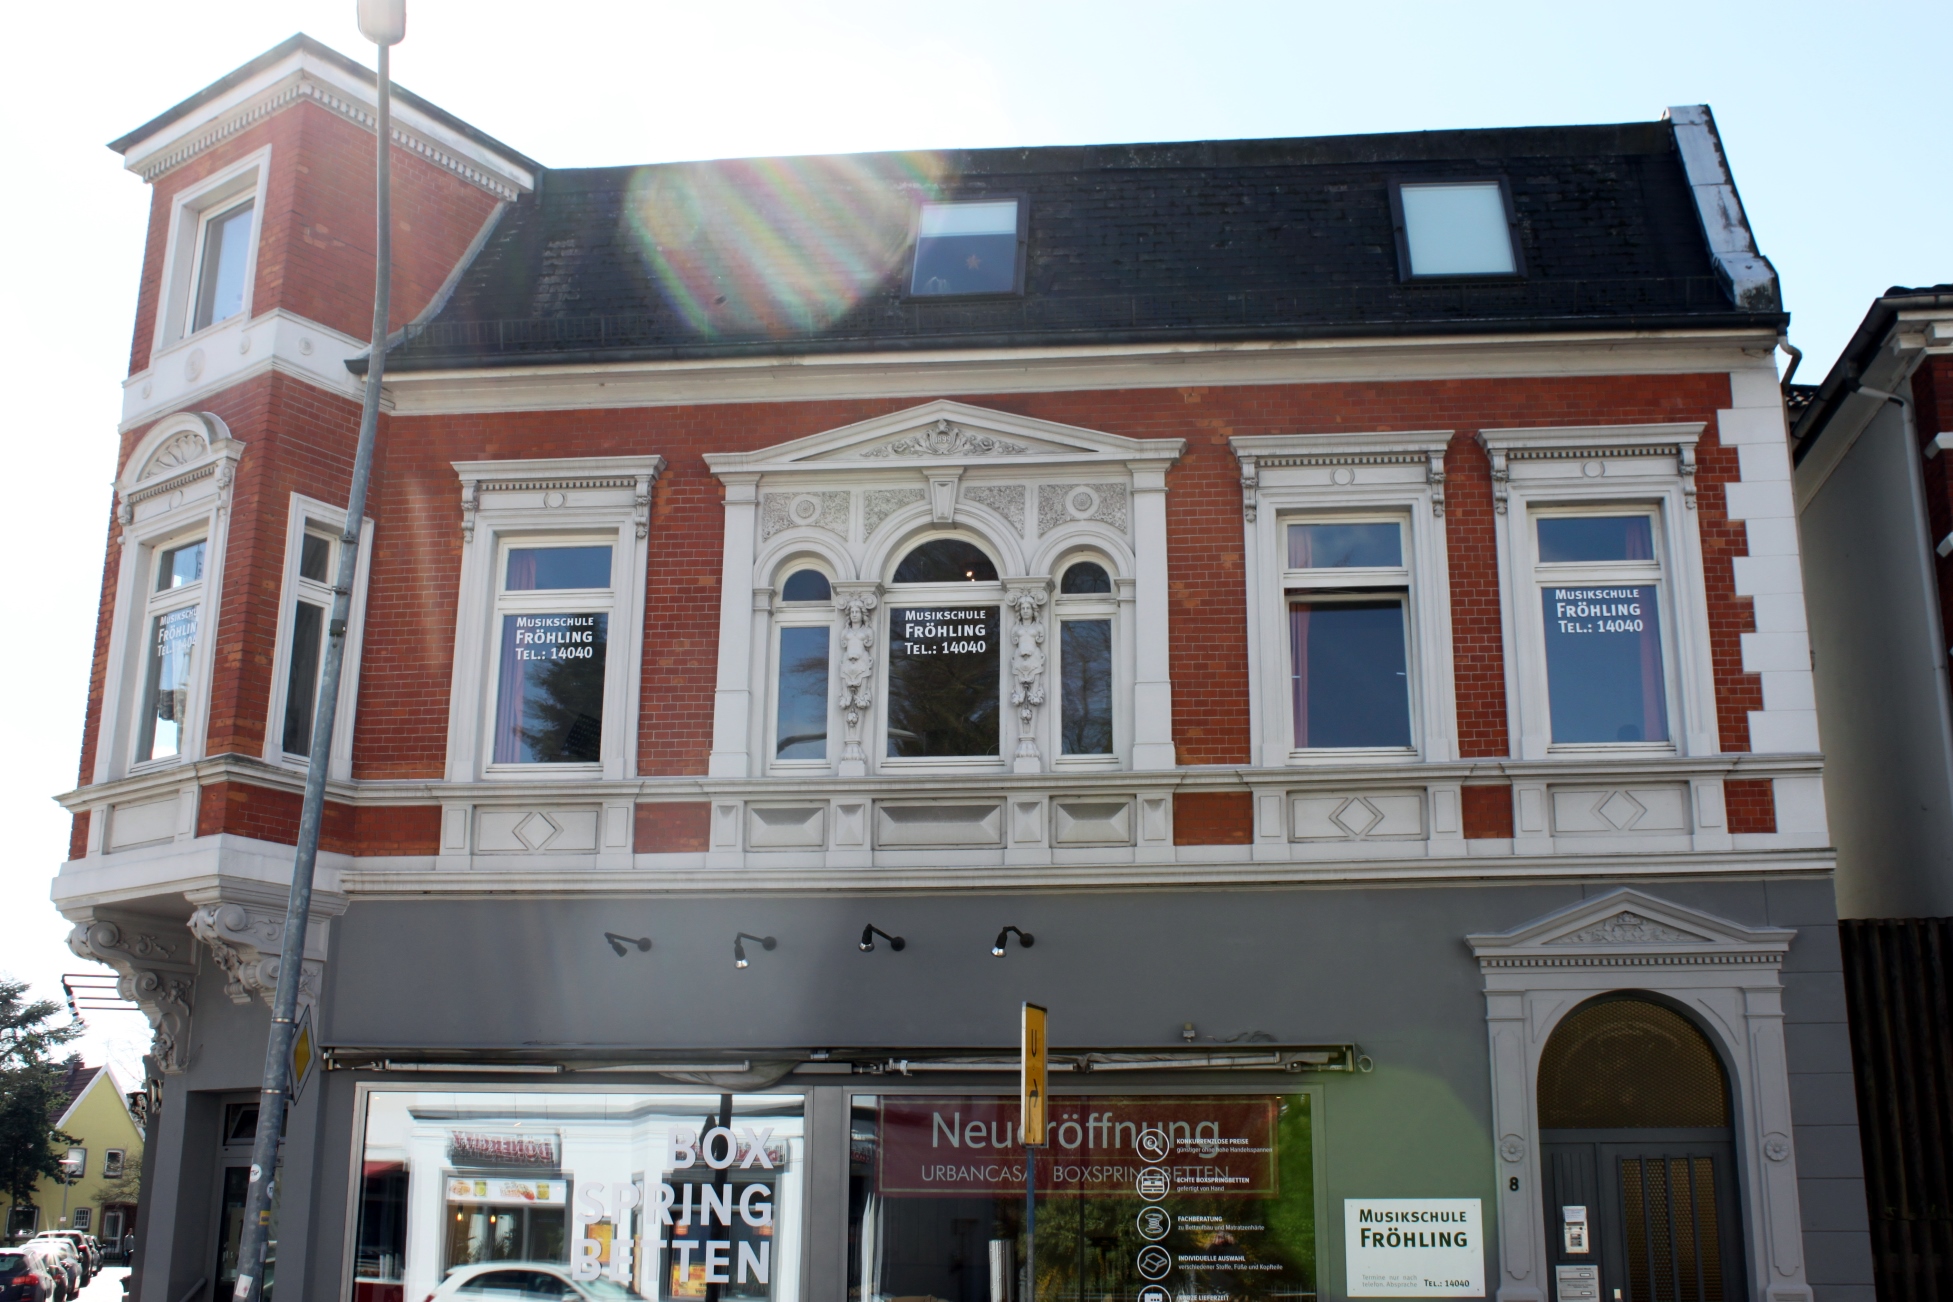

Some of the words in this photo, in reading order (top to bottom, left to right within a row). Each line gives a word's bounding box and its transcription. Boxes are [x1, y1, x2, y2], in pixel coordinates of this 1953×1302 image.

[158, 622, 197, 642] FRÖHLIN
[1597, 620, 1643, 632] 14040
[551, 647, 592, 659] 14040
[942, 641, 986, 653] 14040
[668, 1126, 774, 1170] BOX
[1510, 1176, 1519, 1191] 8
[576, 1182, 772, 1226] SPRING
[572, 1238, 770, 1283] BETTEN
